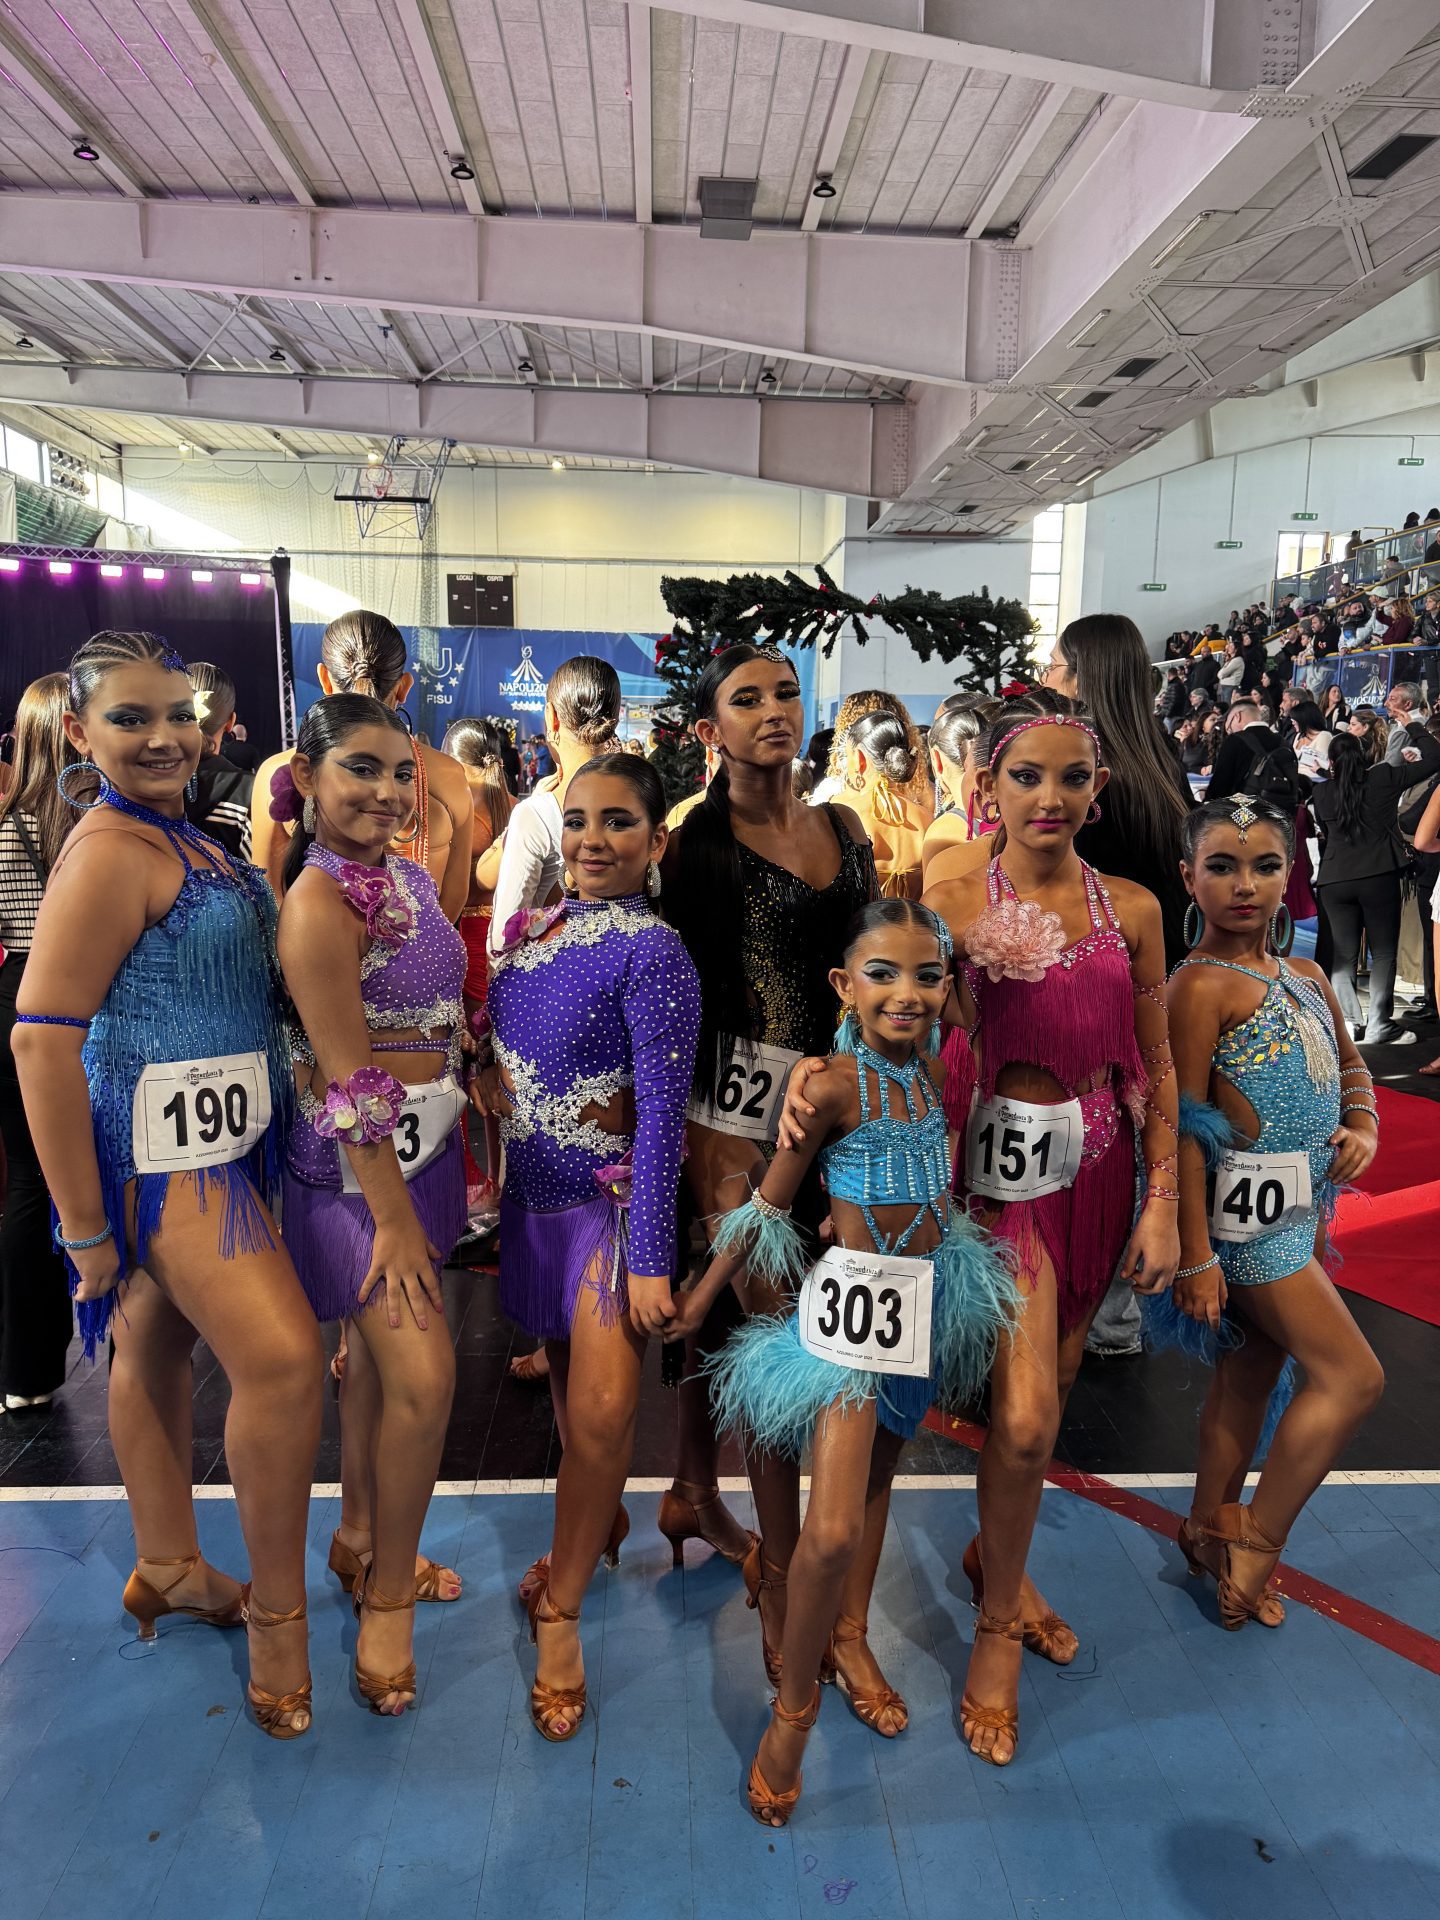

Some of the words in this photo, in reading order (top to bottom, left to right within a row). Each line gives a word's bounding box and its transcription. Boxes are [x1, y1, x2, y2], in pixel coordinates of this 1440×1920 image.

[426, 694, 453, 704] FISU
[163, 1083, 248, 1147] 190
[704, 1064, 773, 1119] 62
[978, 1122, 1052, 1182] 151
[818, 1278, 902, 1349] 303
